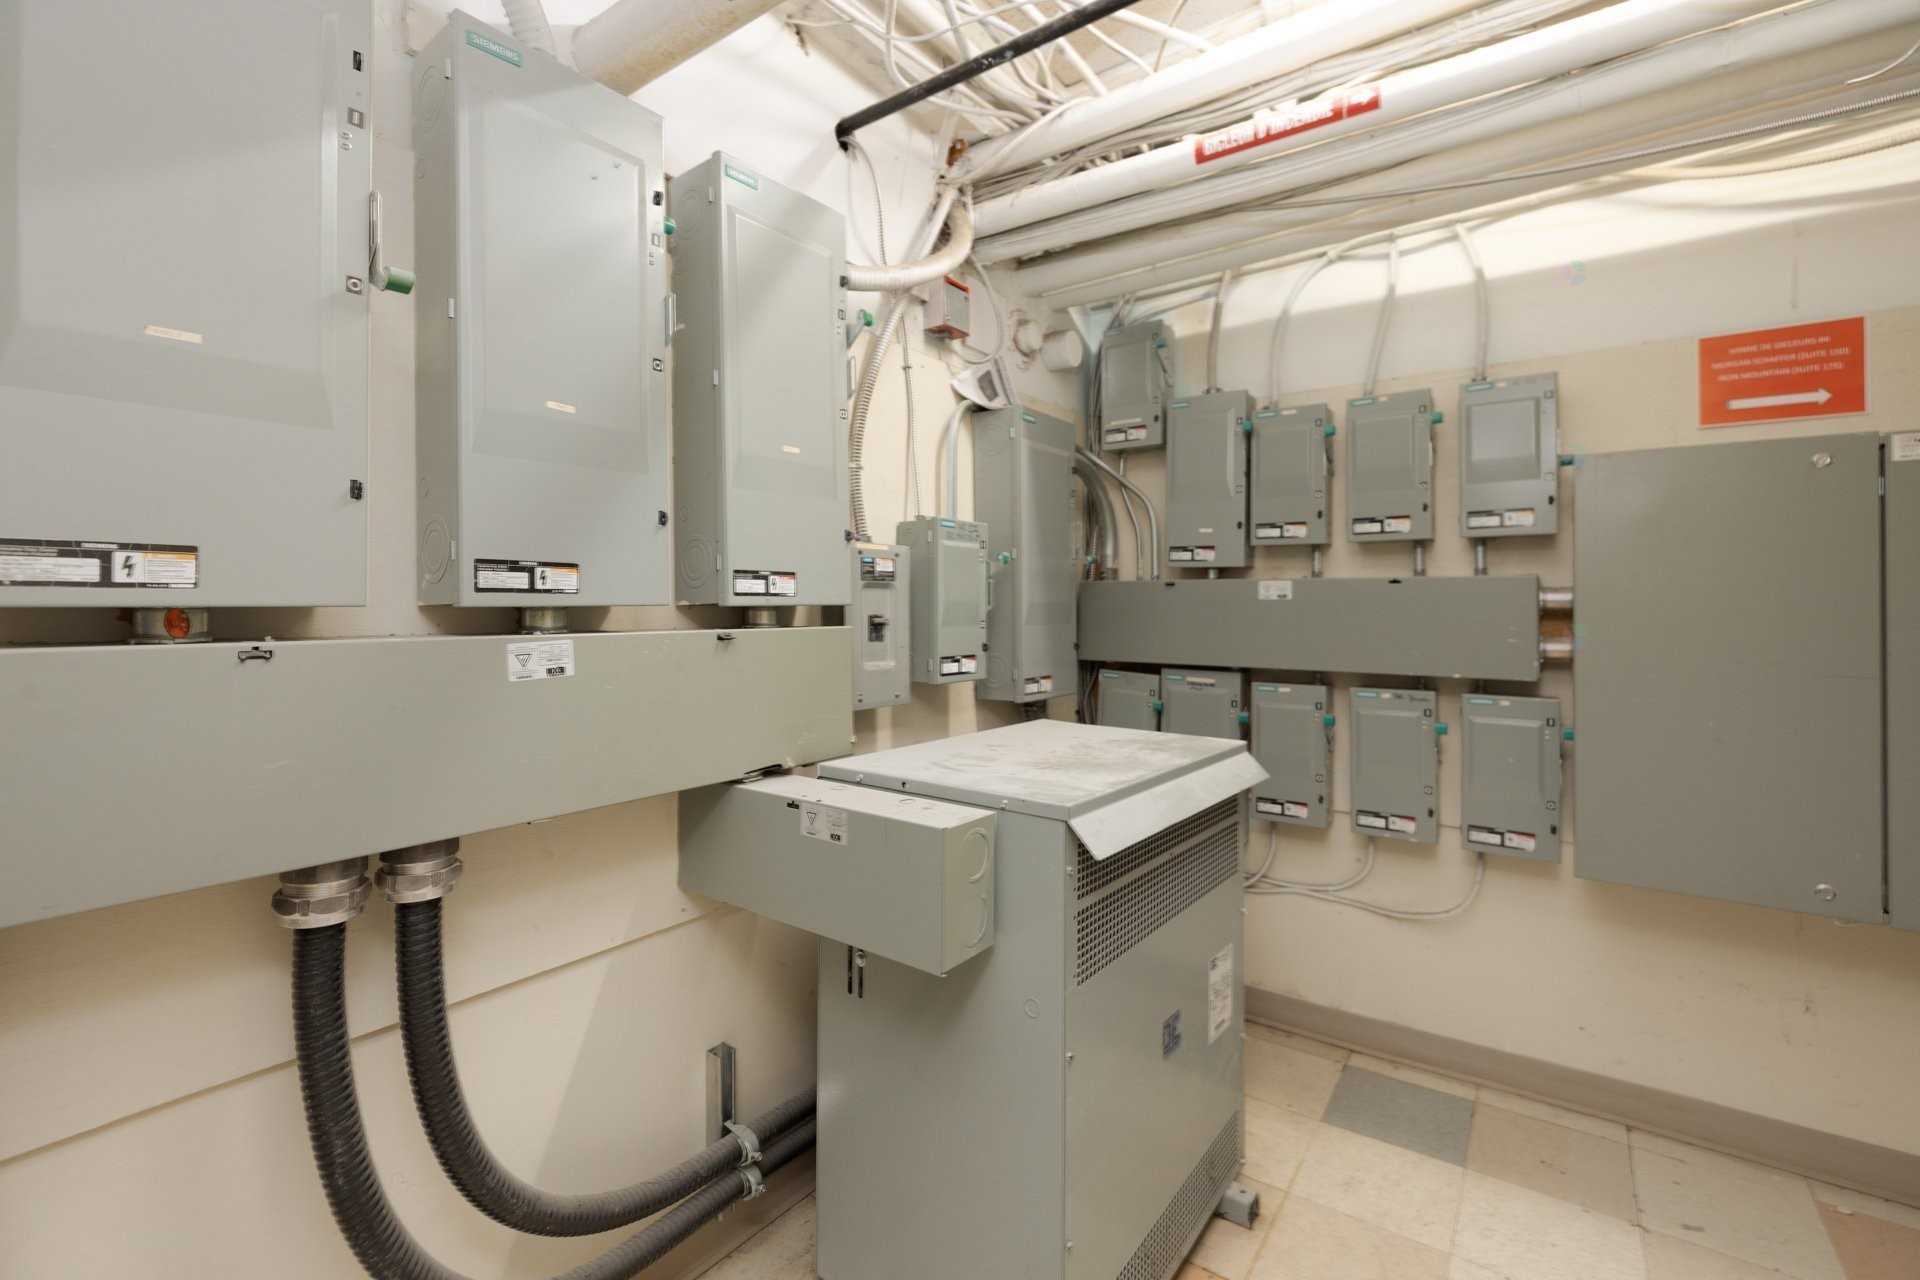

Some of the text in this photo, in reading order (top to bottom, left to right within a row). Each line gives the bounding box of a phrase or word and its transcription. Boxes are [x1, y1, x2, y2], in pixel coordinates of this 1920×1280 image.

[470, 33, 520, 61] SIEMENS
[1760, 342, 1772, 351] DE
[1798, 350, 1827, 361] (SUITE
[1741, 368, 1790, 380] MOUNTAIN
[1791, 364, 1820, 375] (SUITE
